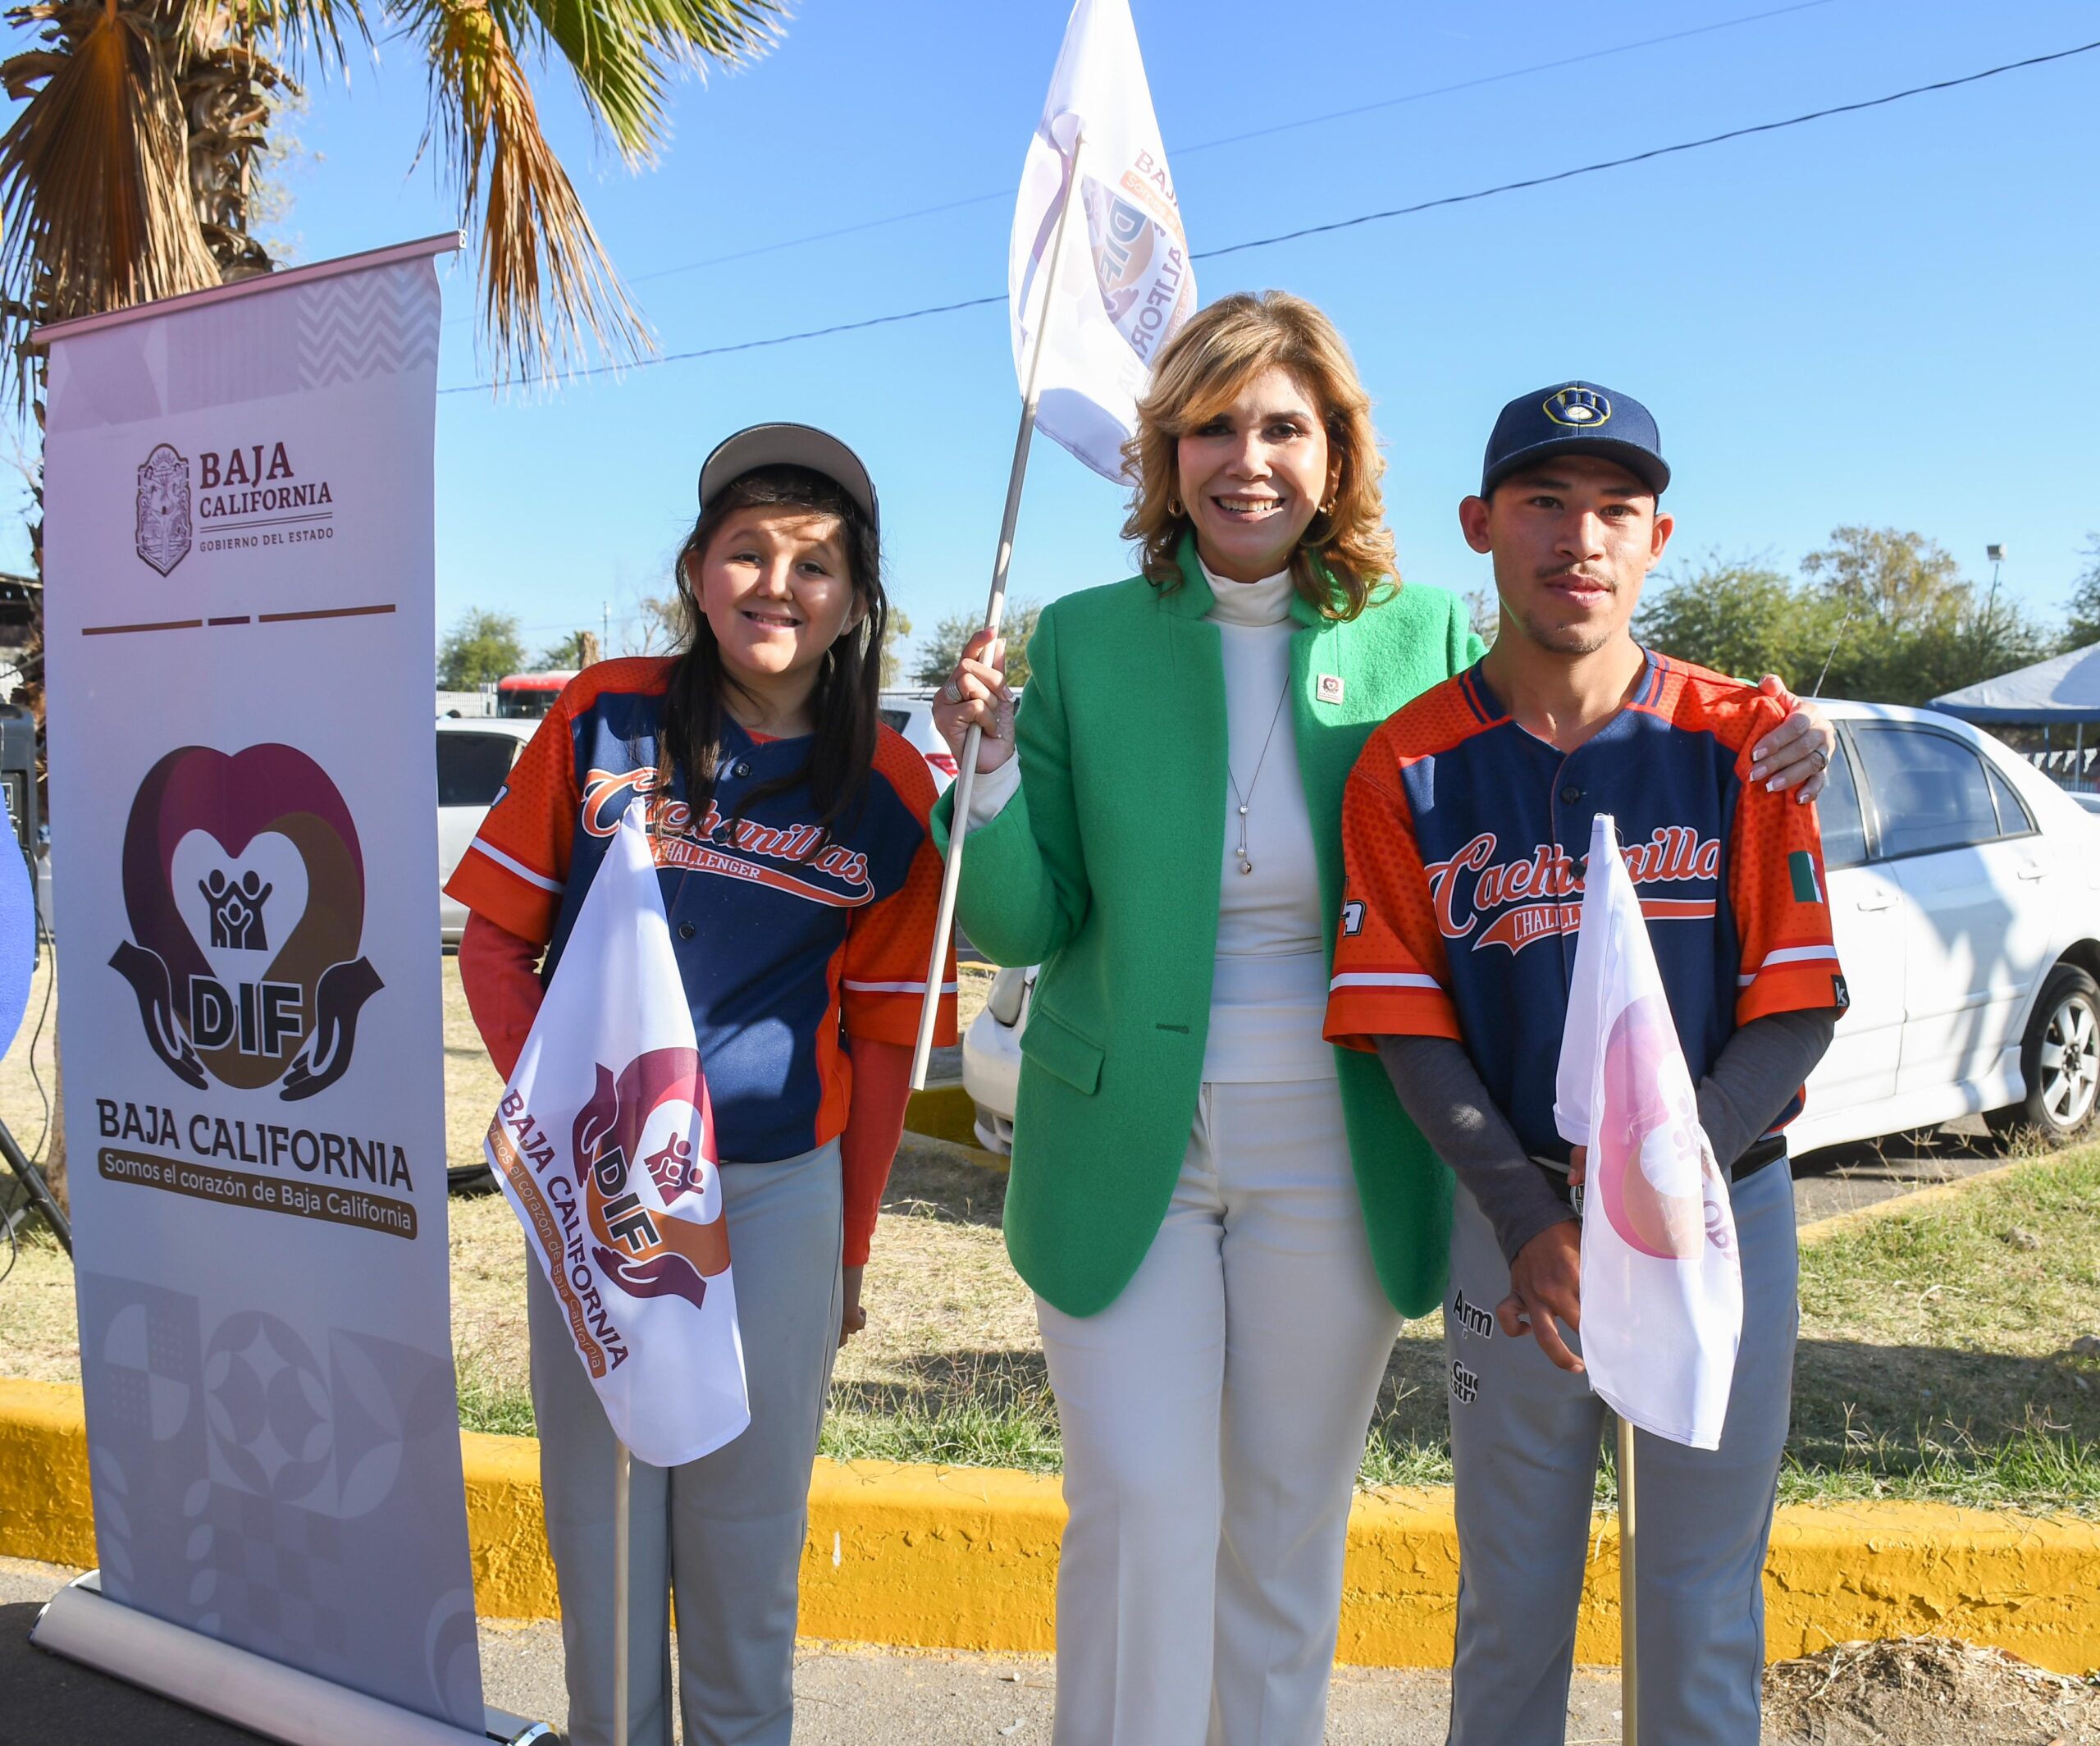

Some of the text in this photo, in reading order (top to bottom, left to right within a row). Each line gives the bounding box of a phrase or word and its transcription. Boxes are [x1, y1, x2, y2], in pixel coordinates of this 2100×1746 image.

[199, 441, 294, 490] BAJA
[199, 482, 333, 519] CALIFORNIA
[199, 528, 334, 553] GOBIERNO DEL ESTADO
[189, 974, 303, 1058] DIF
[96, 1098, 413, 1192] BAJA CALIFORNIA
[105, 1154, 412, 1231] Somos el corazón de Baja California
[501, 1089, 629, 1371] BAJA CALIFORNIA
[593, 1145, 663, 1255] DIF
[490, 1122, 514, 1165] omos
[509, 1166, 525, 1180] el
[518, 1181, 552, 1239] corazón
[548, 1241, 563, 1261] de
[569, 1299, 601, 1369] California
[1453, 1288, 1494, 1339] Arm
